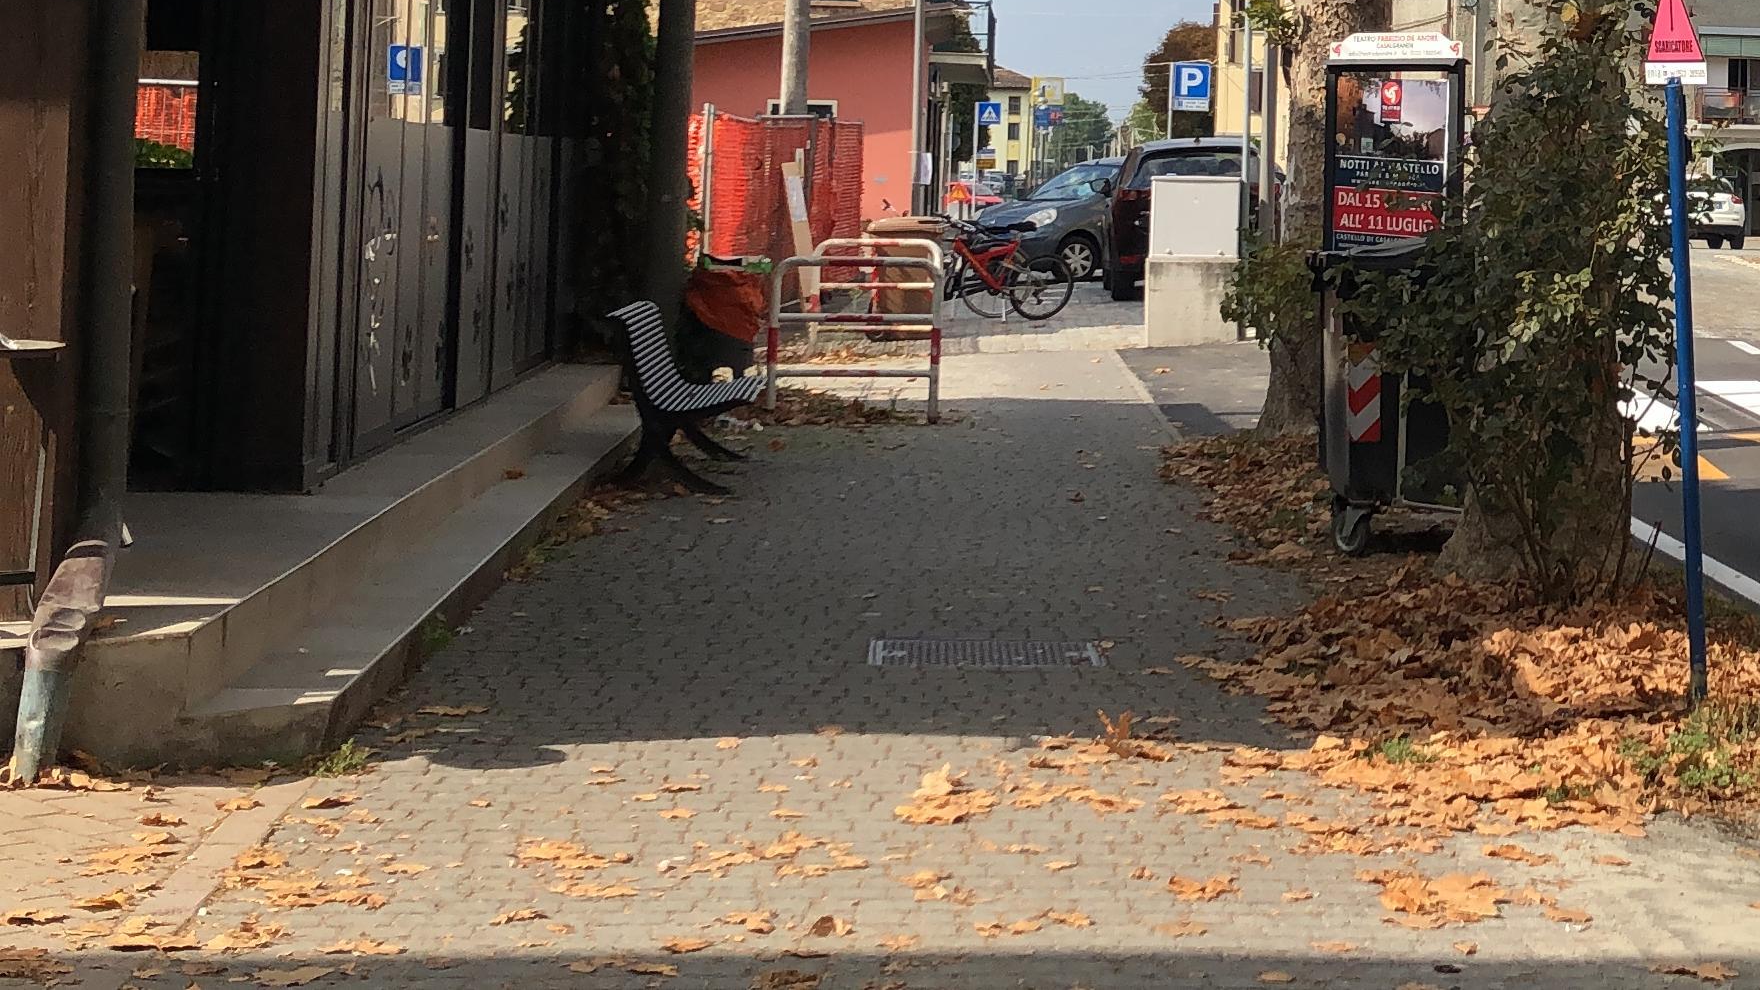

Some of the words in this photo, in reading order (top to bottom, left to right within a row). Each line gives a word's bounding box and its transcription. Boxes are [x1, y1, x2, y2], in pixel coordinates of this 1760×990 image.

[1655, 40, 1693, 53] SCARICATORE
[1180, 67, 1204, 96] P
[1339, 158, 1370, 170] NOTTI
[1337, 191, 1363, 207] DAL
[1364, 193, 1381, 209] 15
[1367, 215, 1384, 230] 11
[1386, 216, 1435, 234] LUGLIO
